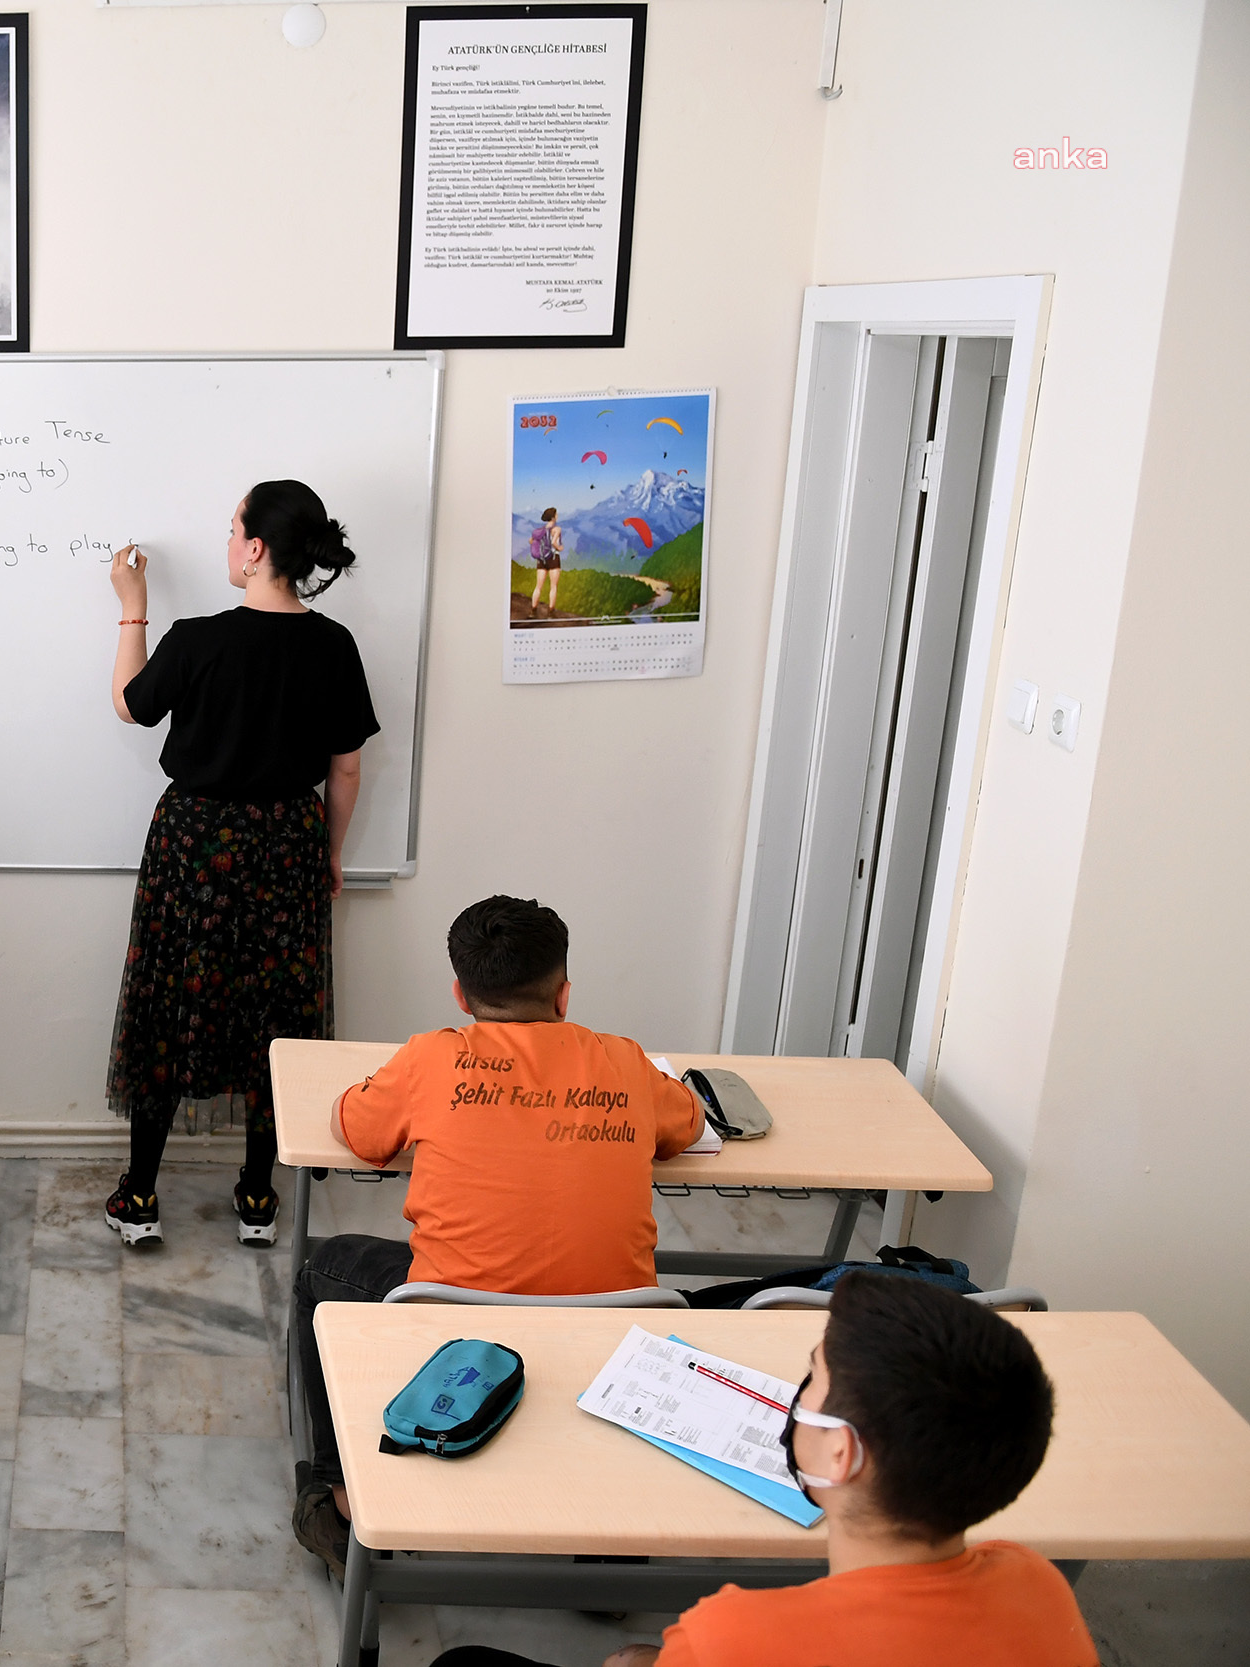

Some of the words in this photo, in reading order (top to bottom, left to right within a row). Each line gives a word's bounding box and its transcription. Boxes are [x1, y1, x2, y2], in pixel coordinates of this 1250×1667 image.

[447, 44, 508, 54] ATATÜRK'ÜN
[510, 43, 560, 55] GENÇLİĞE
[562, 42, 606, 53] HİTABESİ
[44, 420, 111, 444] Tense
[26, 534, 48, 554] to
[69, 534, 114, 562] play
[454, 1051, 514, 1072] Tarsus
[450, 1082, 504, 1110] Şehit
[510, 1086, 556, 1108] Fazlı
[564, 1086, 629, 1114] Kalaycı
[546, 1119, 636, 1144] Ortaokulu
